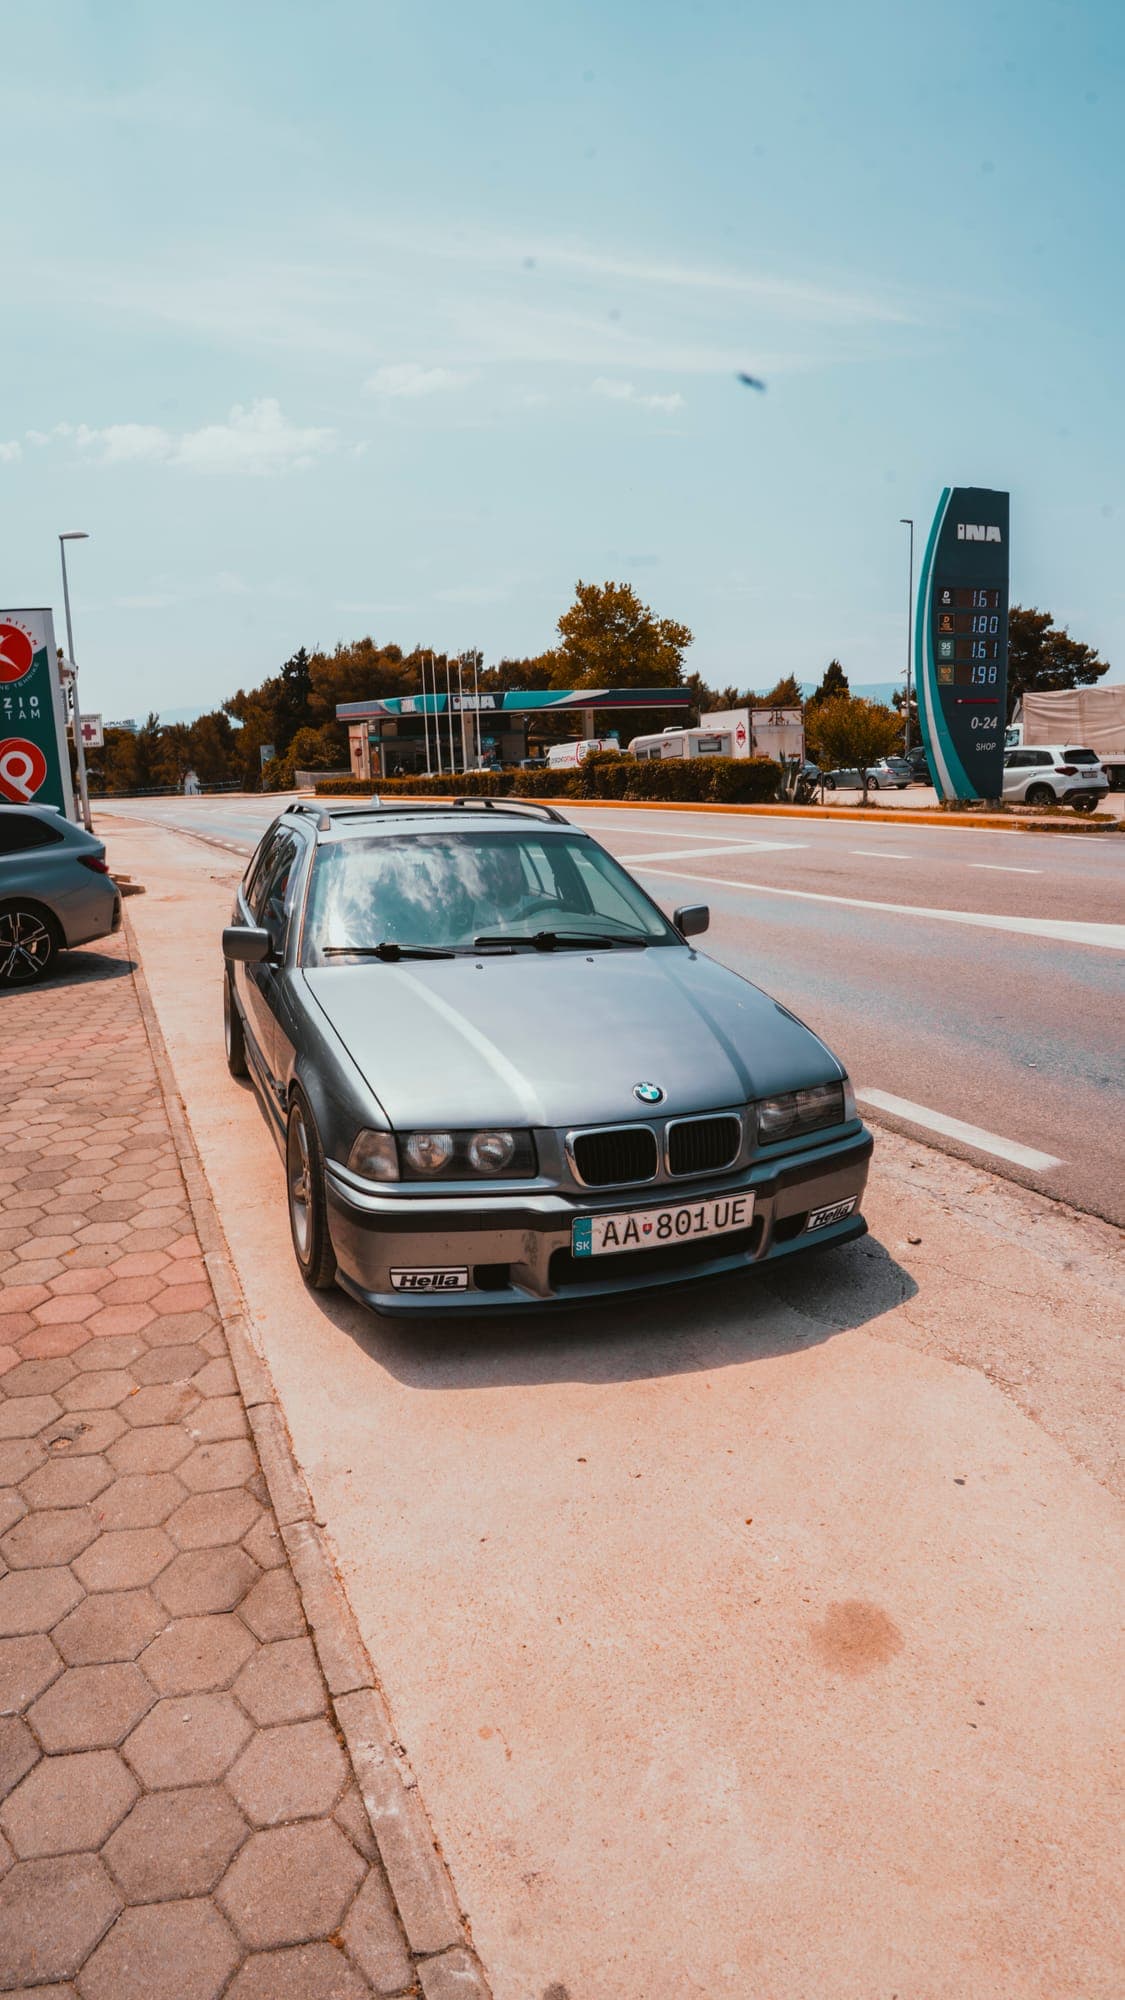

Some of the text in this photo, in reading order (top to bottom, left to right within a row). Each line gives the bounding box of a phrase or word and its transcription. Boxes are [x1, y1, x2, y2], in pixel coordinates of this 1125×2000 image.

[957, 523, 1001, 543] INA
[3, 696, 39, 709] ZIO
[5, 709, 41, 720] TAM
[970, 716, 998, 729] 0-24
[975, 742, 997, 752] SHOP
[814, 1204, 850, 1225] Hella
[575, 1240, 591, 1251] SK
[400, 1274, 459, 1287] Hella
